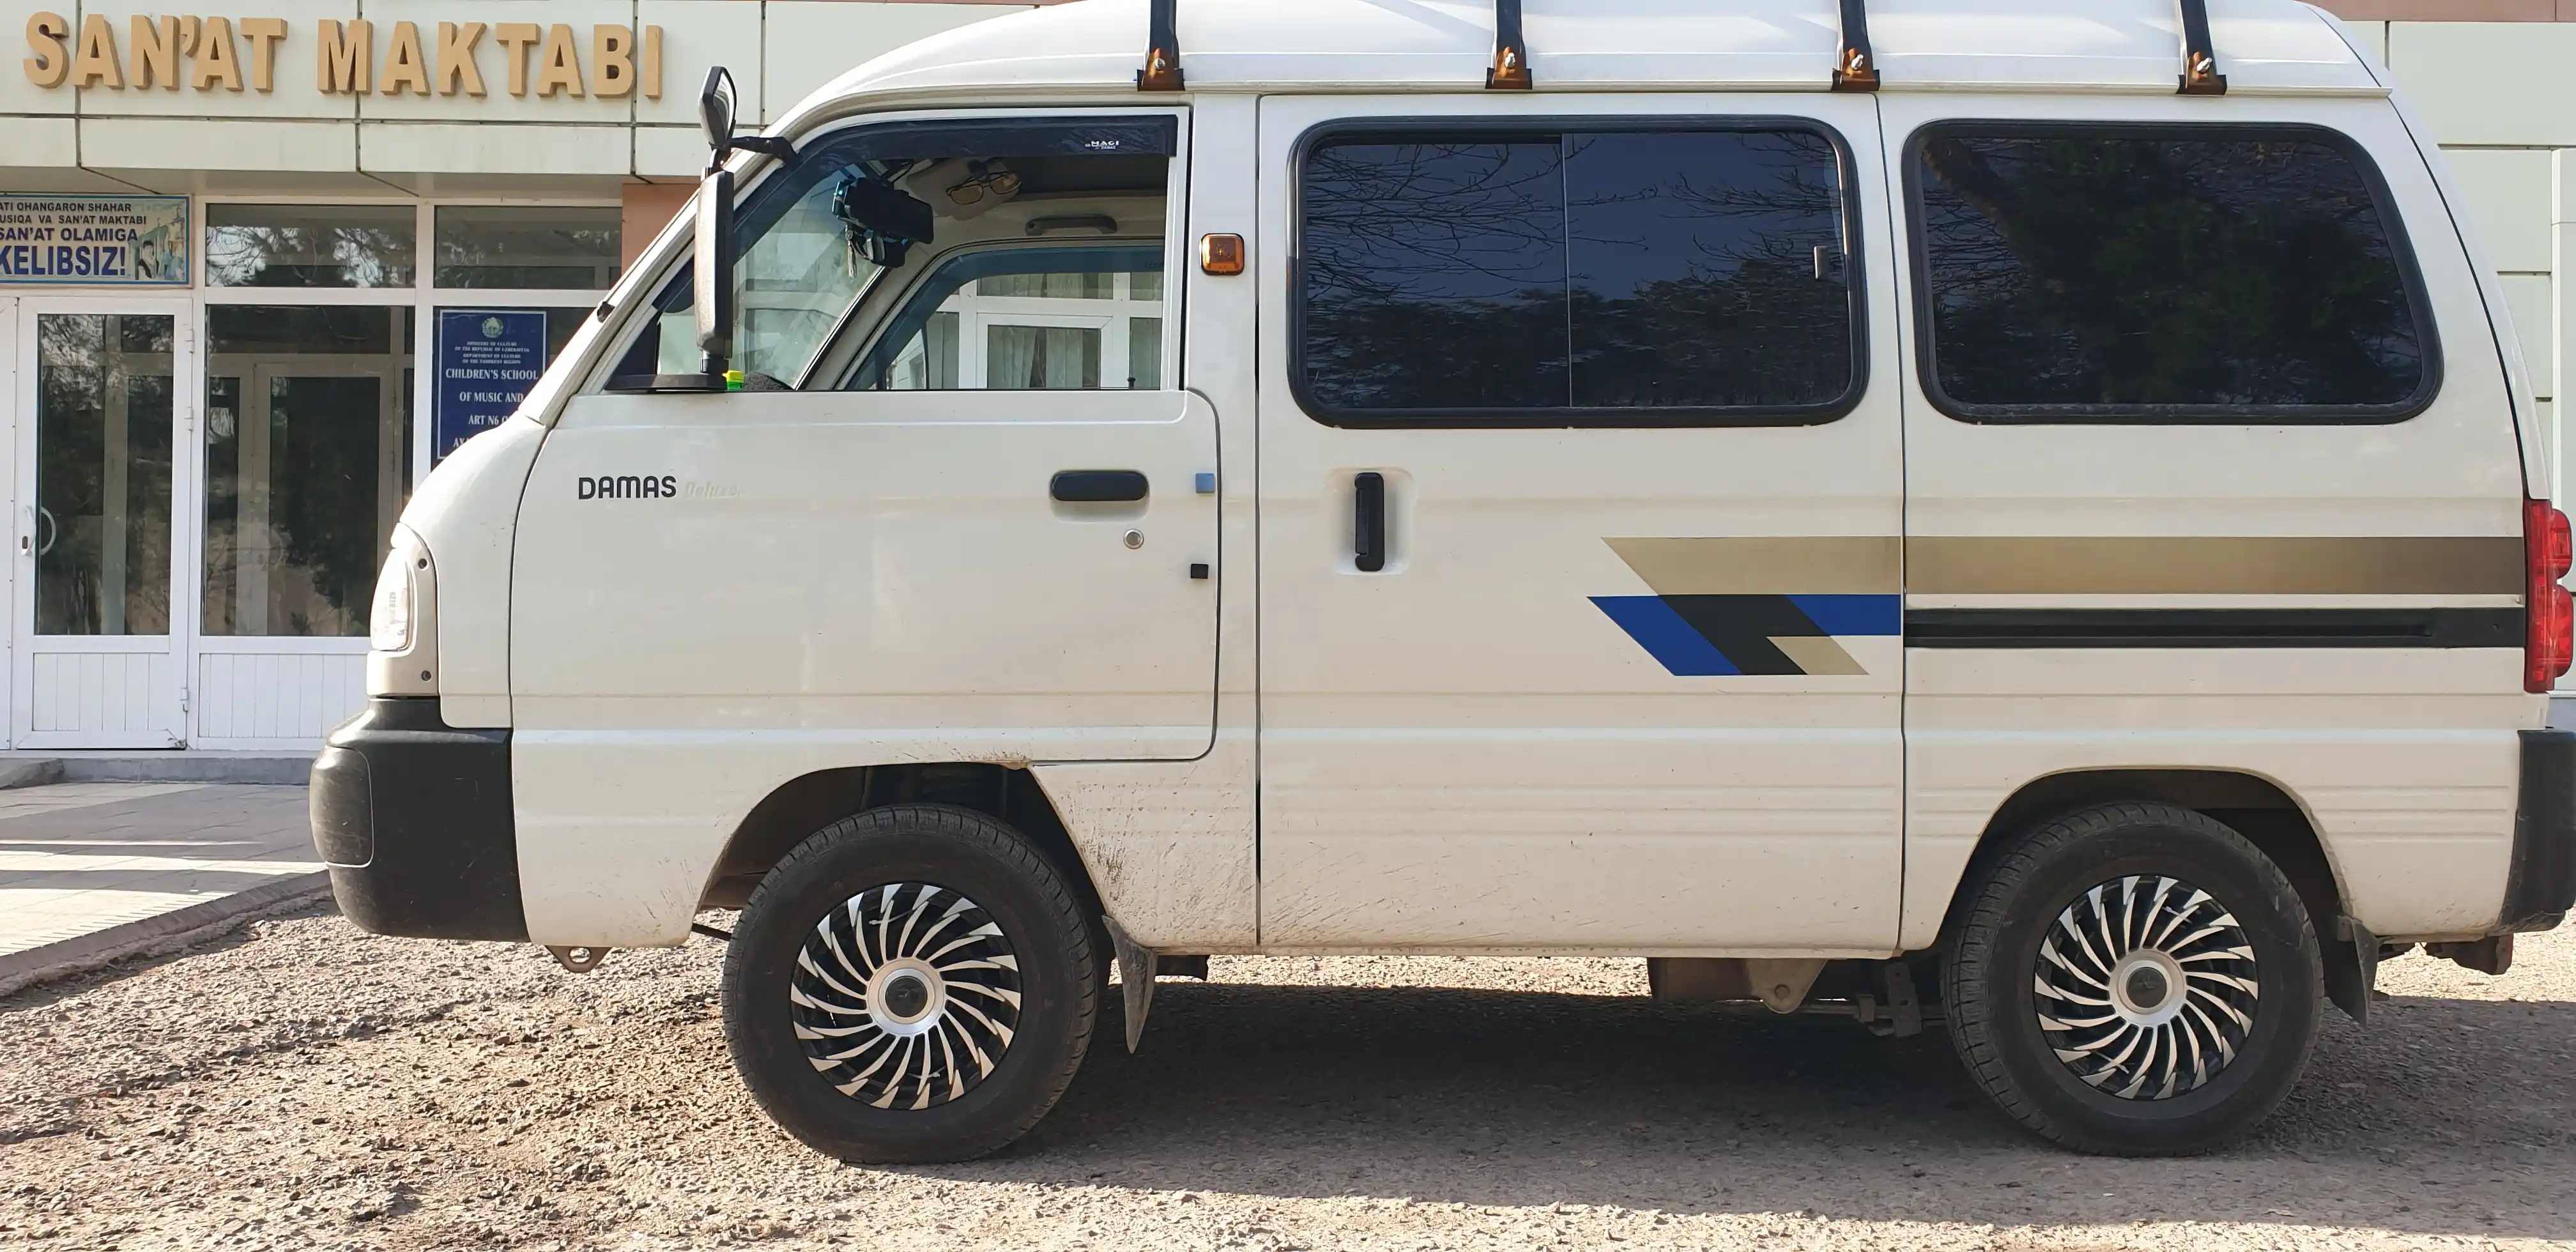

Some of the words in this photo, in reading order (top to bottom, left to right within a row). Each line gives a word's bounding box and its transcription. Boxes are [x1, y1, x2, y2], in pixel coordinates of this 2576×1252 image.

[316, 20, 663, 100] MAKTABI
[88, 202, 132, 212] SHAHAR
[38, 215, 52, 224] VA
[99, 215, 147, 225] MAKTABI
[60, 228, 139, 242] OLAMIGA
[501, 369, 539, 380] SCHOOL
[459, 392, 471, 402] OF
[473, 392, 502, 402] MUSIC
[505, 392, 524, 403] AND
[468, 415, 486, 425] ART
[578, 475, 677, 500] DAMAS
